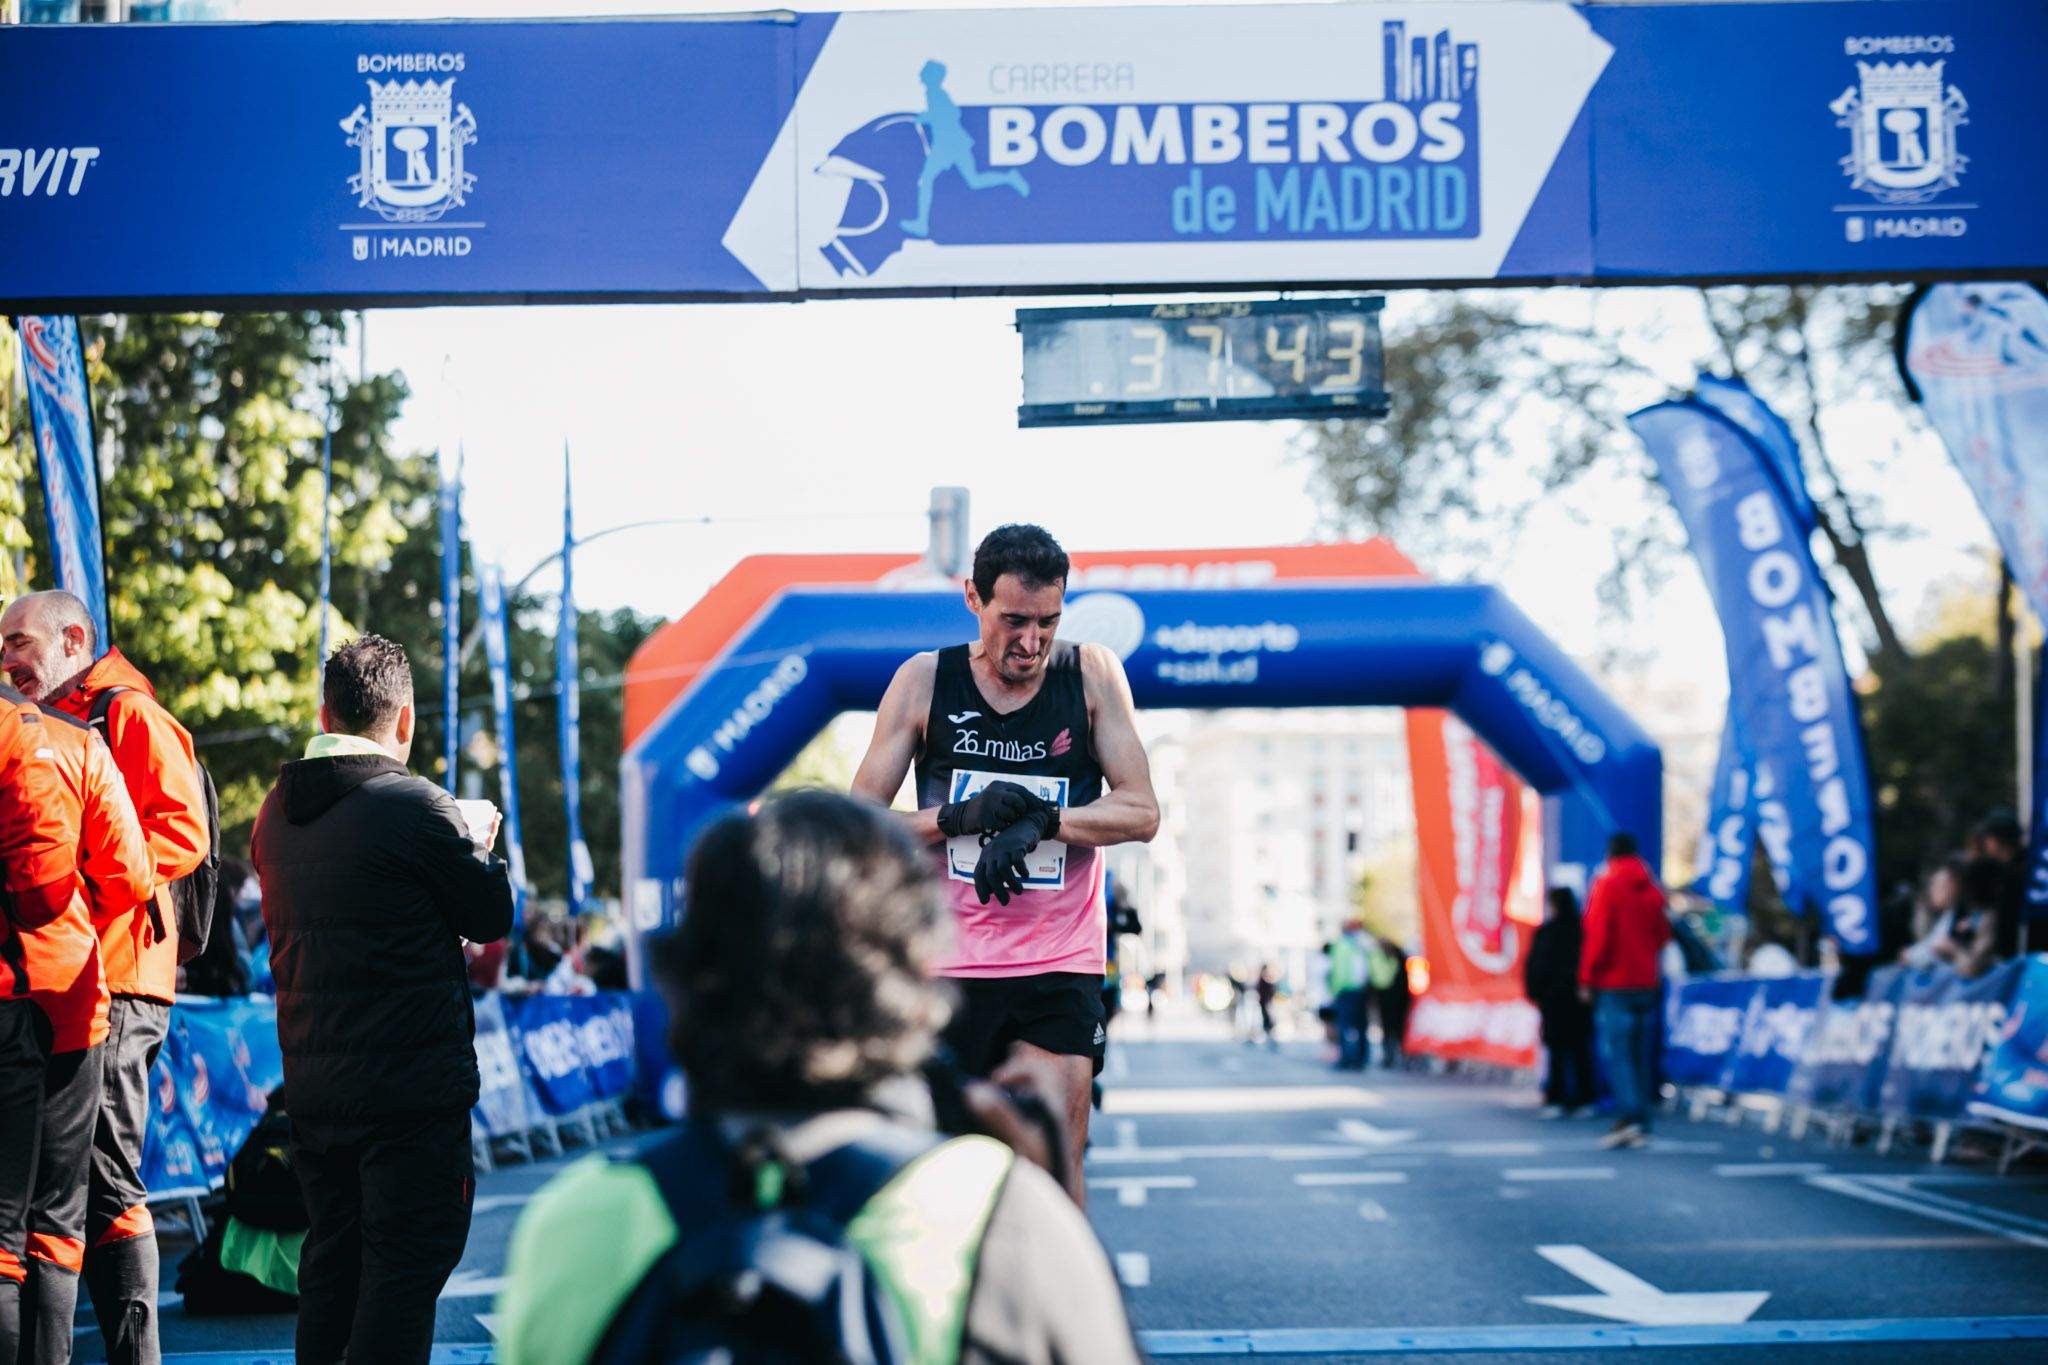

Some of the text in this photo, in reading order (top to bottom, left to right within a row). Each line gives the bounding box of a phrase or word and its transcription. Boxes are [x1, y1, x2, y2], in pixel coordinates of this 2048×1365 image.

[1844, 36, 1955, 56] BOMBEROS
[357, 52, 465, 74] BOMBEROS
[988, 62, 1135, 95] CARRERA
[988, 103, 1464, 167] BOMBEROS
[1171, 166, 1466, 234] de MADRID
[1874, 217, 1967, 239] MADRID
[381, 235, 472, 258] MADRID
[953, 728, 979, 754] 26
